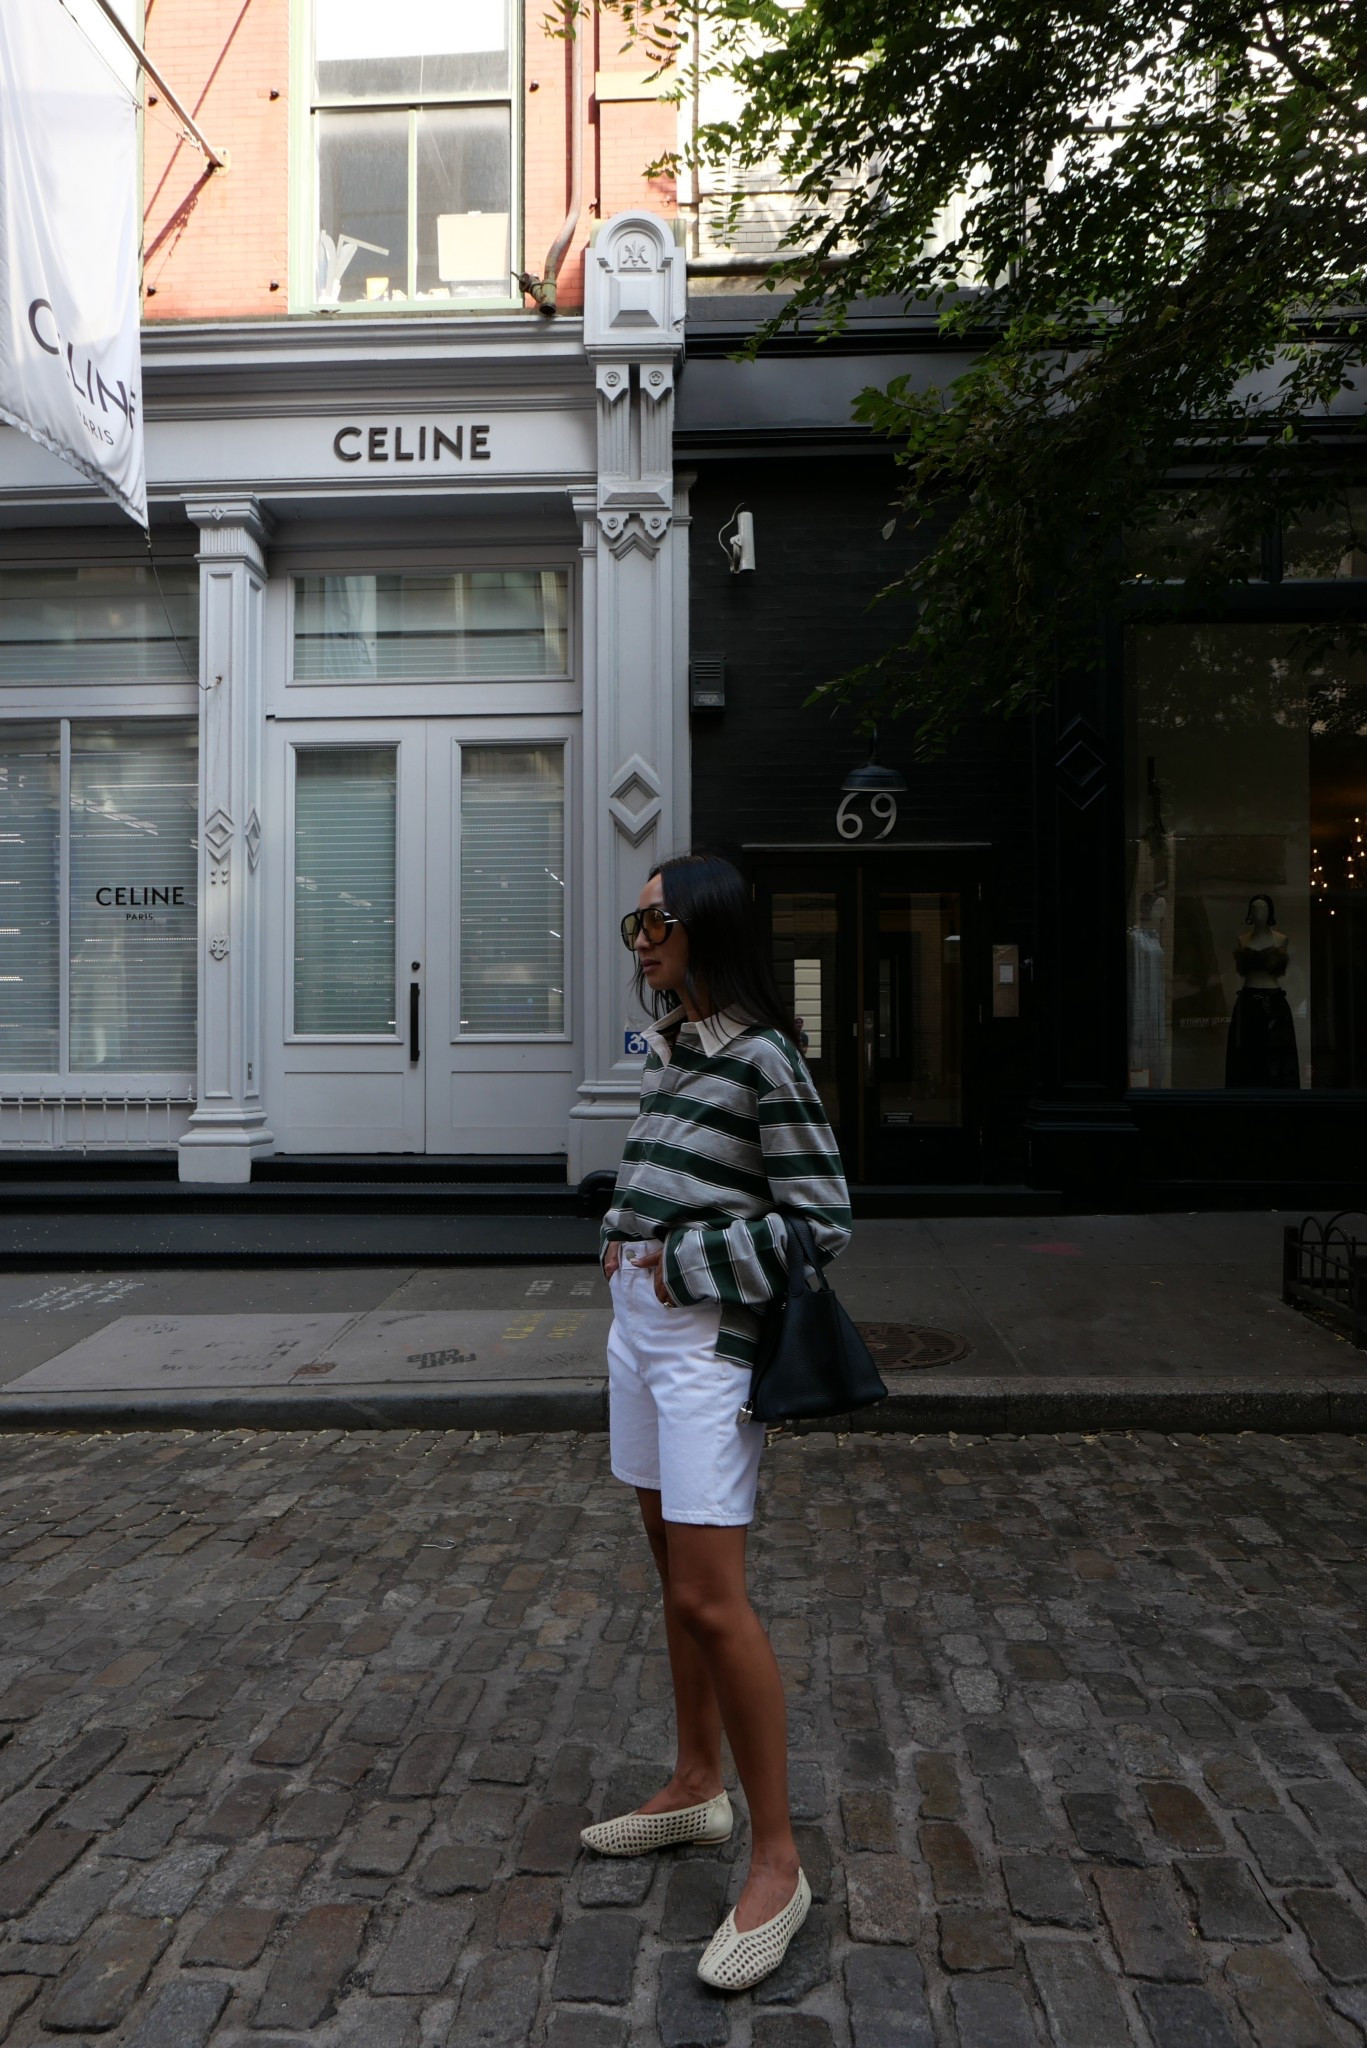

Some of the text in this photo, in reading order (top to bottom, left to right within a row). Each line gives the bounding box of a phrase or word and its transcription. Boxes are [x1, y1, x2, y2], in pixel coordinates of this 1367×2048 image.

[77, 405, 115, 446] ARIS
[333, 424, 491, 461] CELINE
[836, 792, 897, 840] 69
[96, 887, 184, 906] CELINE
[126, 913, 154, 921] PARIS
